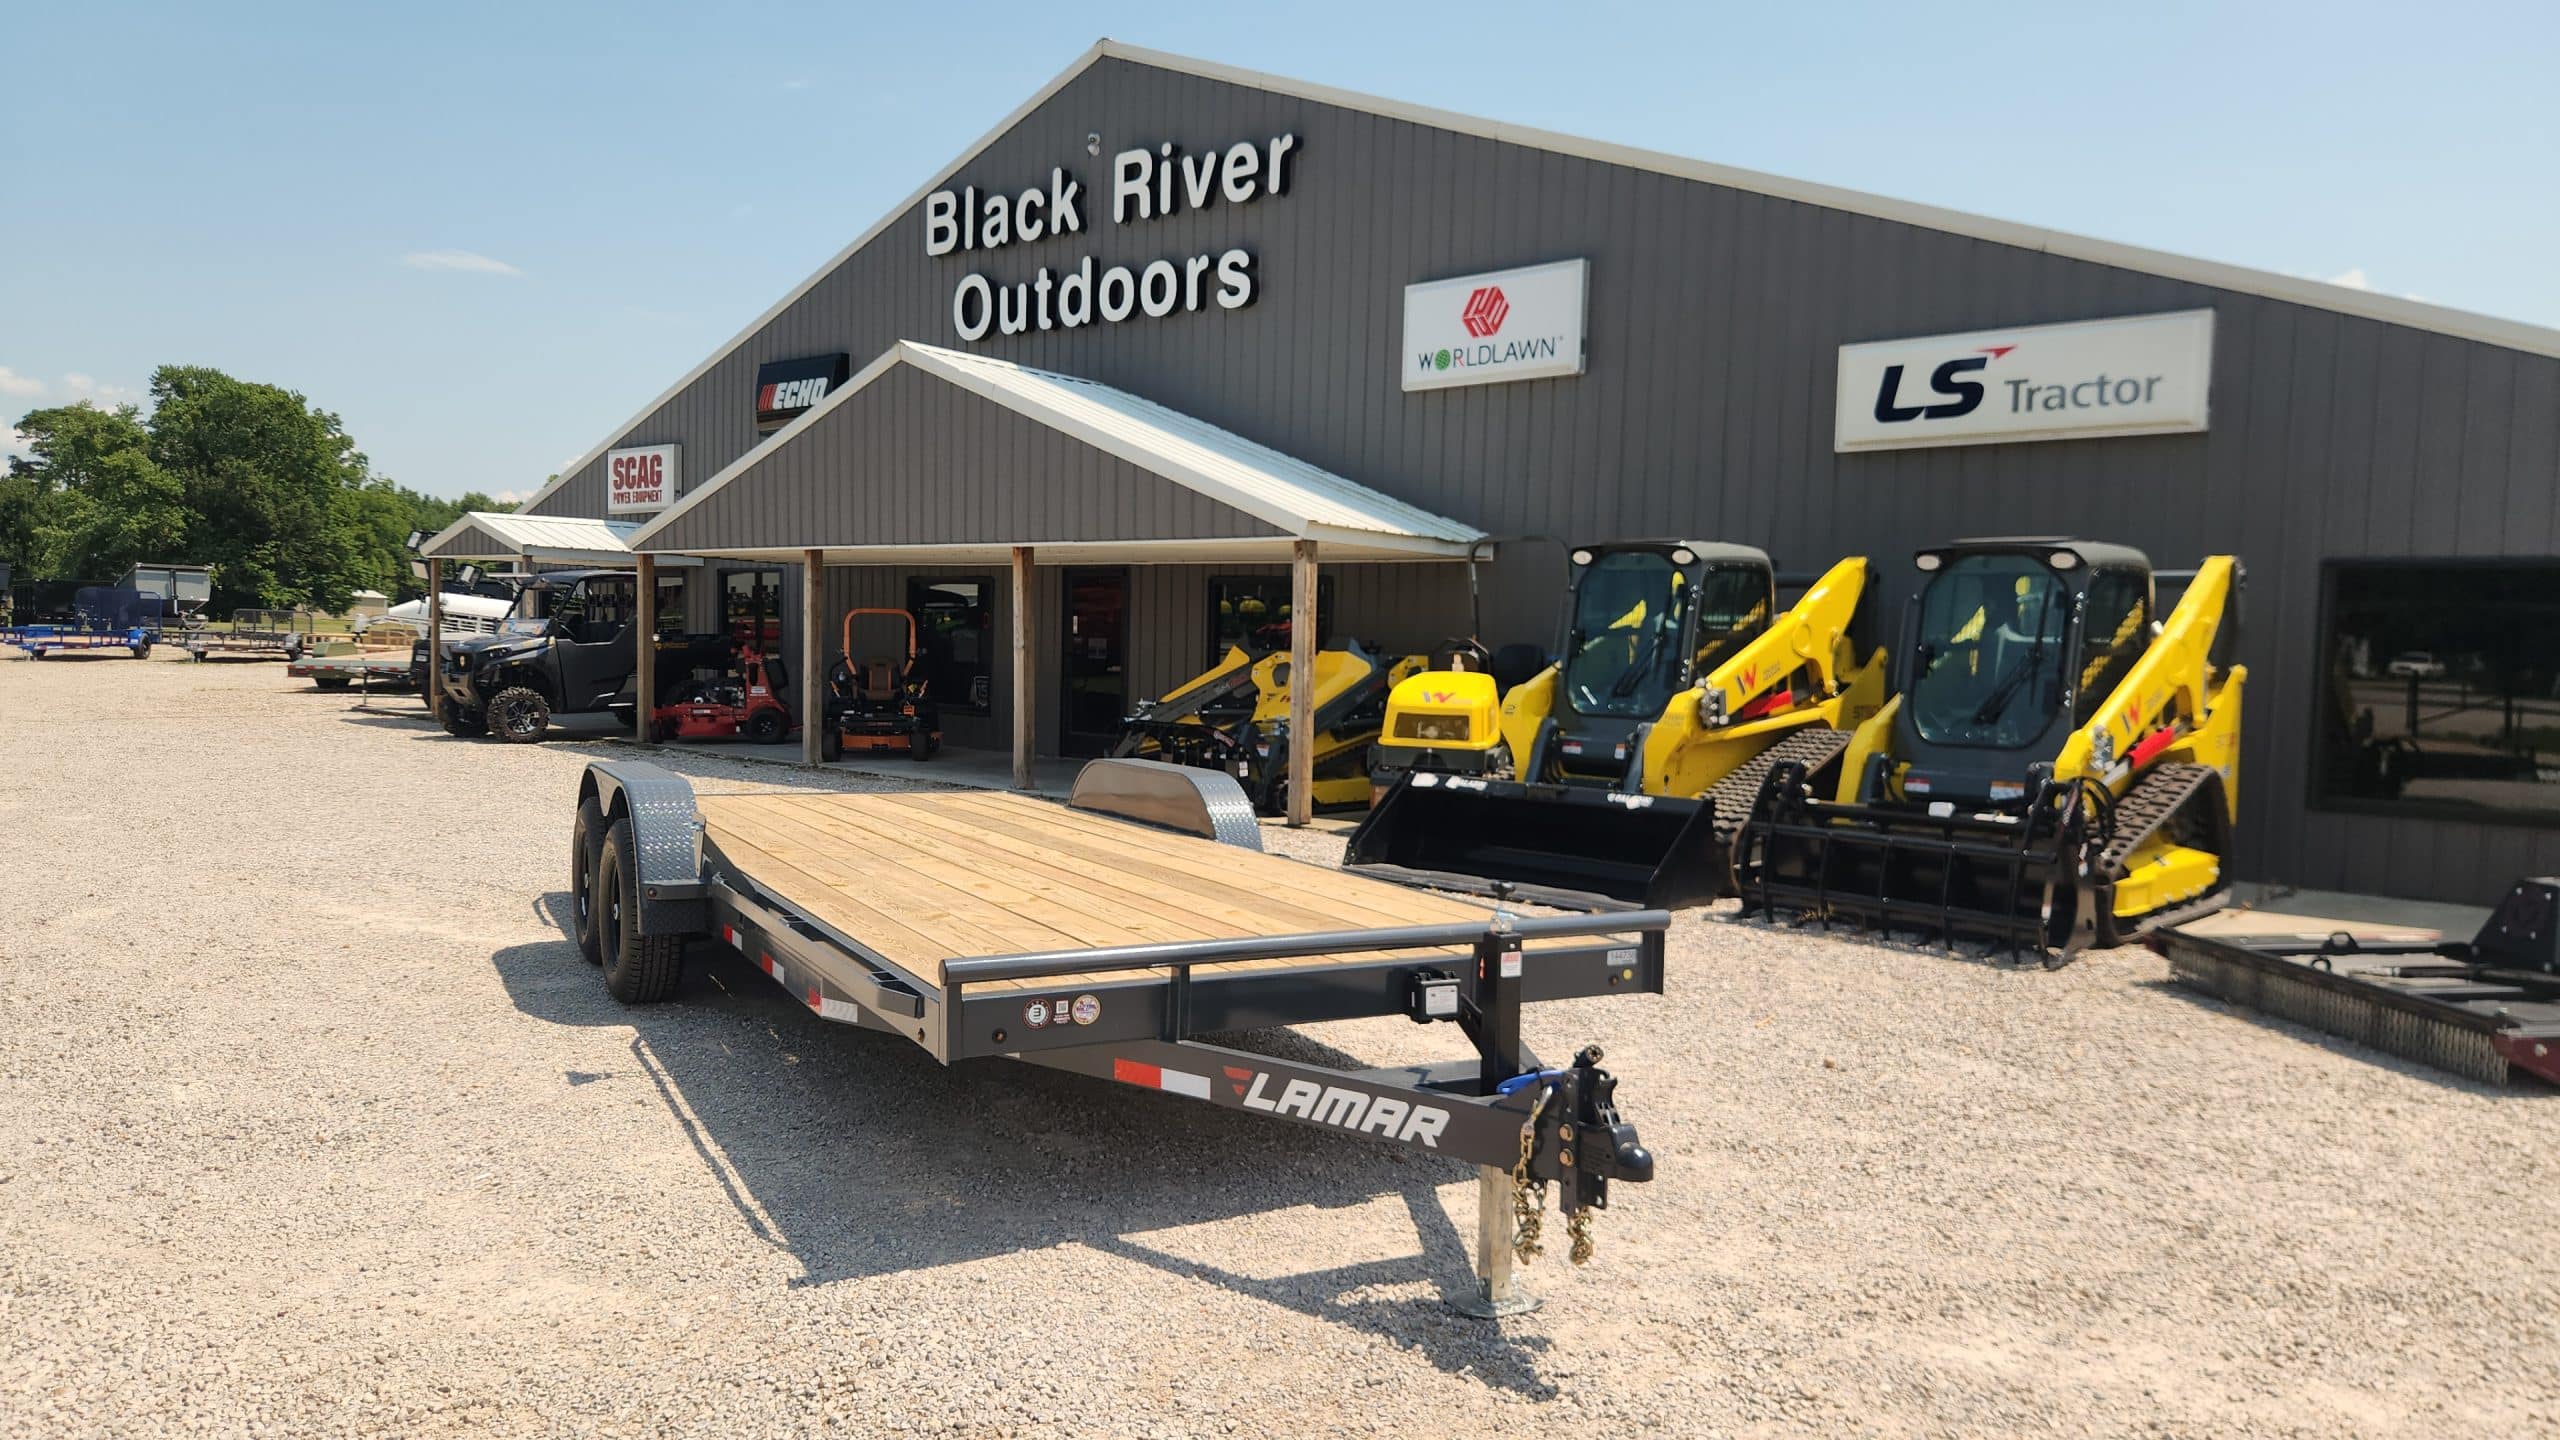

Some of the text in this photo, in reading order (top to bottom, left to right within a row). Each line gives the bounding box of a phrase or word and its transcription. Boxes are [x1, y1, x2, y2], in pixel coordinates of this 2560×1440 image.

[926, 132, 1296, 257] Black River
[953, 248, 1252, 342] Outdoors
[1418, 337, 1556, 373] WORLDLAWN
[772, 376, 829, 410] ECHO
[1873, 355, 2164, 424] LS Tractor
[612, 454, 663, 490] SCAG
[613, 491, 631, 505] POWER
[1242, 1072, 1451, 1149] LAMAR
